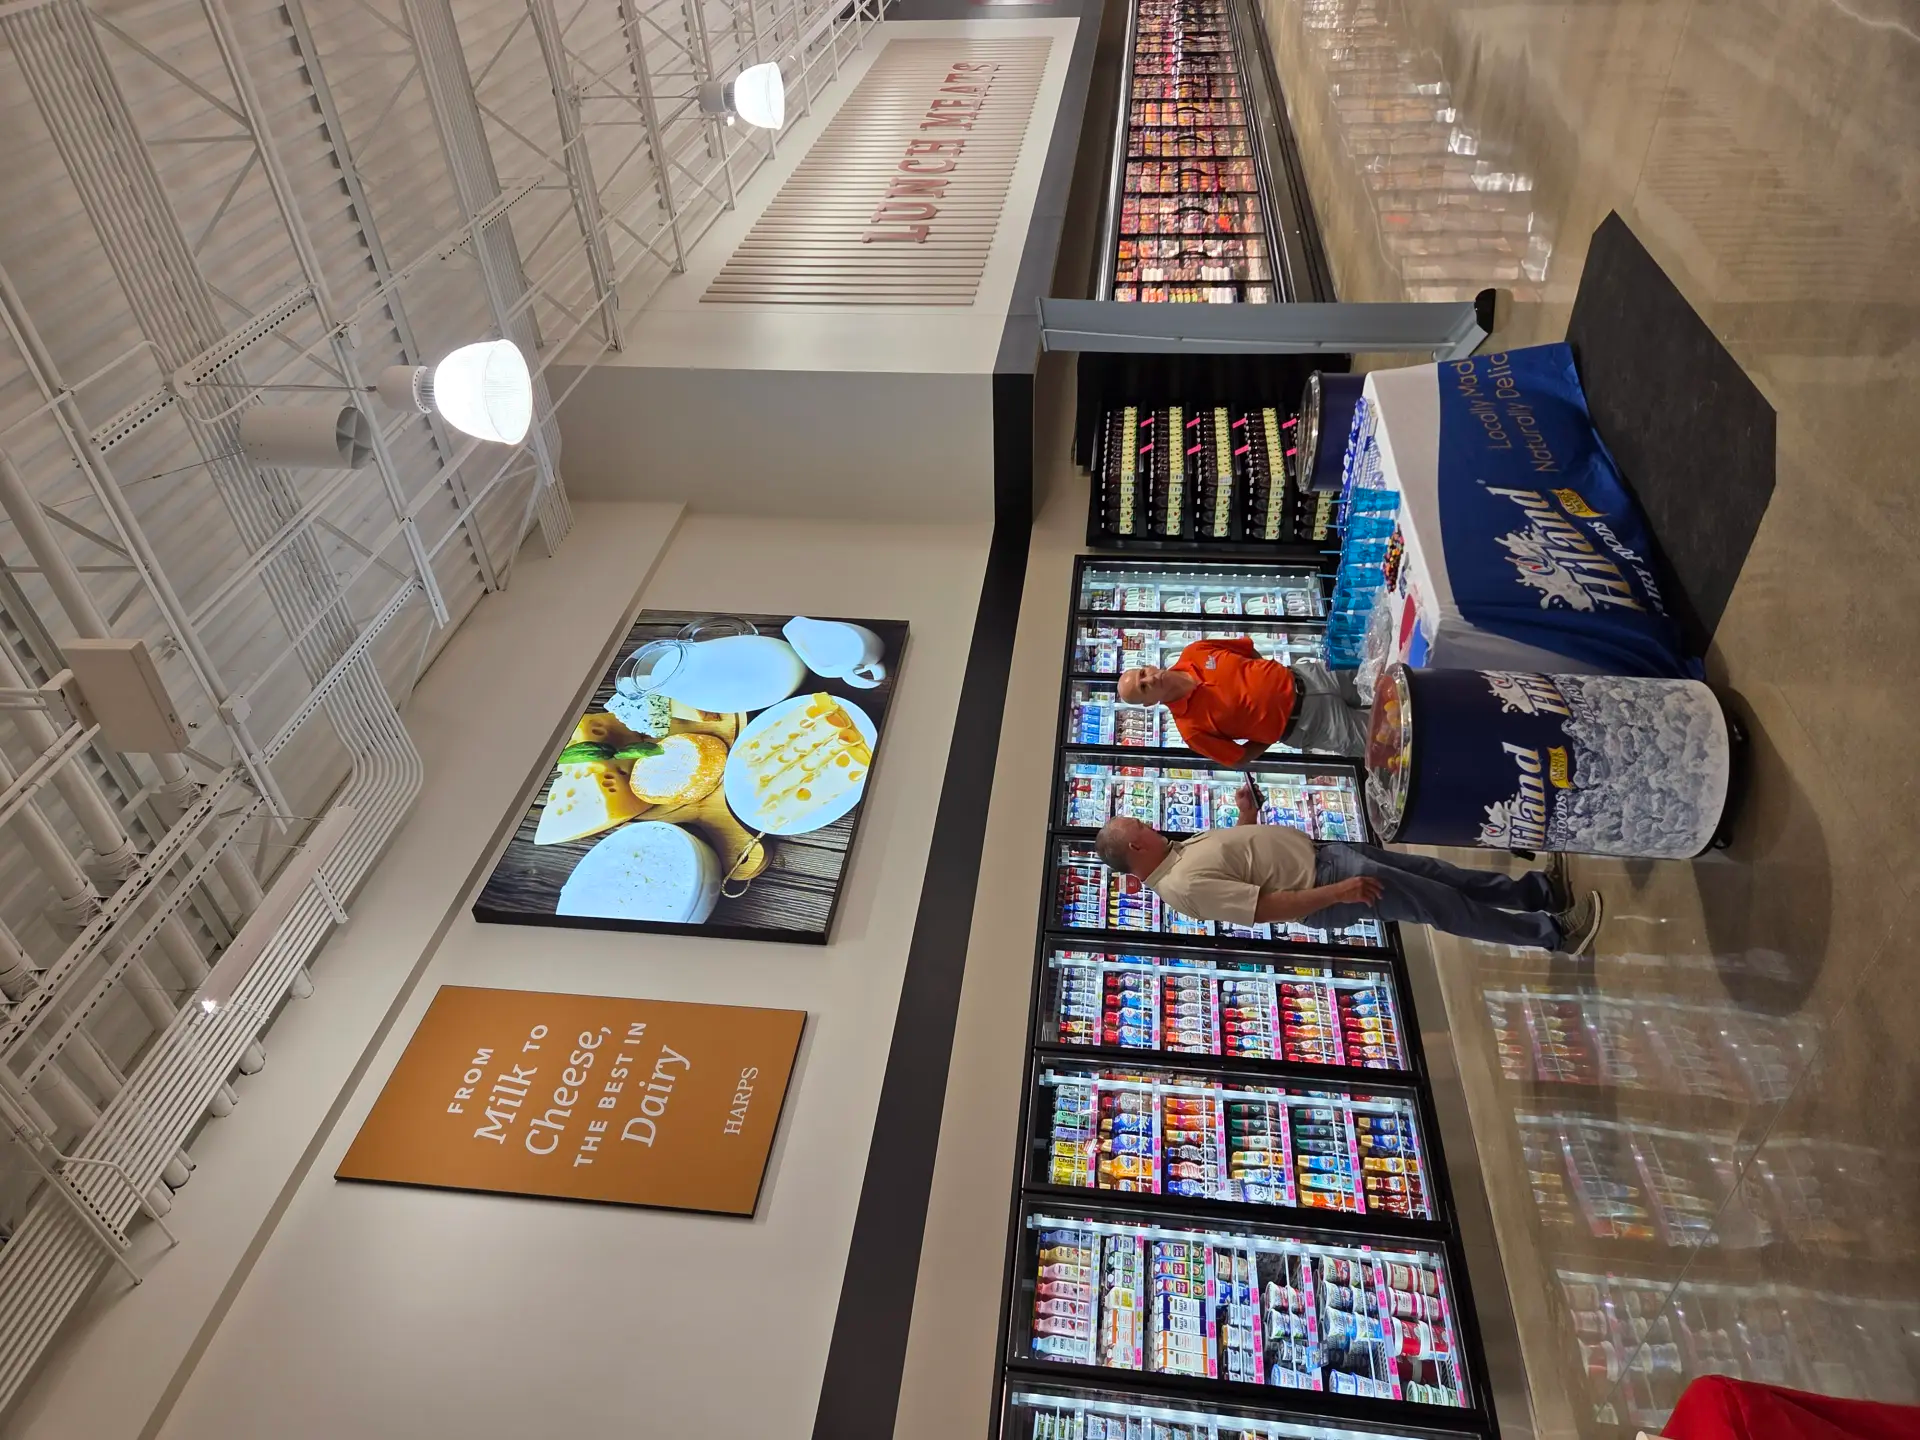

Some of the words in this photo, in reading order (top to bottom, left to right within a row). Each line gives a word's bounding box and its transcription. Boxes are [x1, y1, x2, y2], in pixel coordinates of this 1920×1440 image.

[861, 139, 966, 244] LUNCH
[919, 62, 999, 132] MEATS
[1450, 359, 1484, 396] Mad
[1485, 352, 1521, 398] Delic
[1469, 400, 1512, 449] Locally
[1506, 402, 1560, 472] Naturally
[1485, 486, 1648, 612] Hiland
[1587, 521, 1644, 563] FOODS
[1502, 741, 1546, 848] Hiland
[1555, 794, 1568, 834] FOODS
[446, 1048, 494, 1114] FROM
[474, 1064, 538, 1144] Milk
[522, 1024, 549, 1053] TO
[525, 1025, 612, 1155] Cheese,
[573, 1121, 608, 1167] THE
[598, 1053, 635, 1109] BEST
[625, 1022, 647, 1045] IN
[621, 1044, 691, 1147] Dairy
[724, 1067, 758, 1134] HARPS
